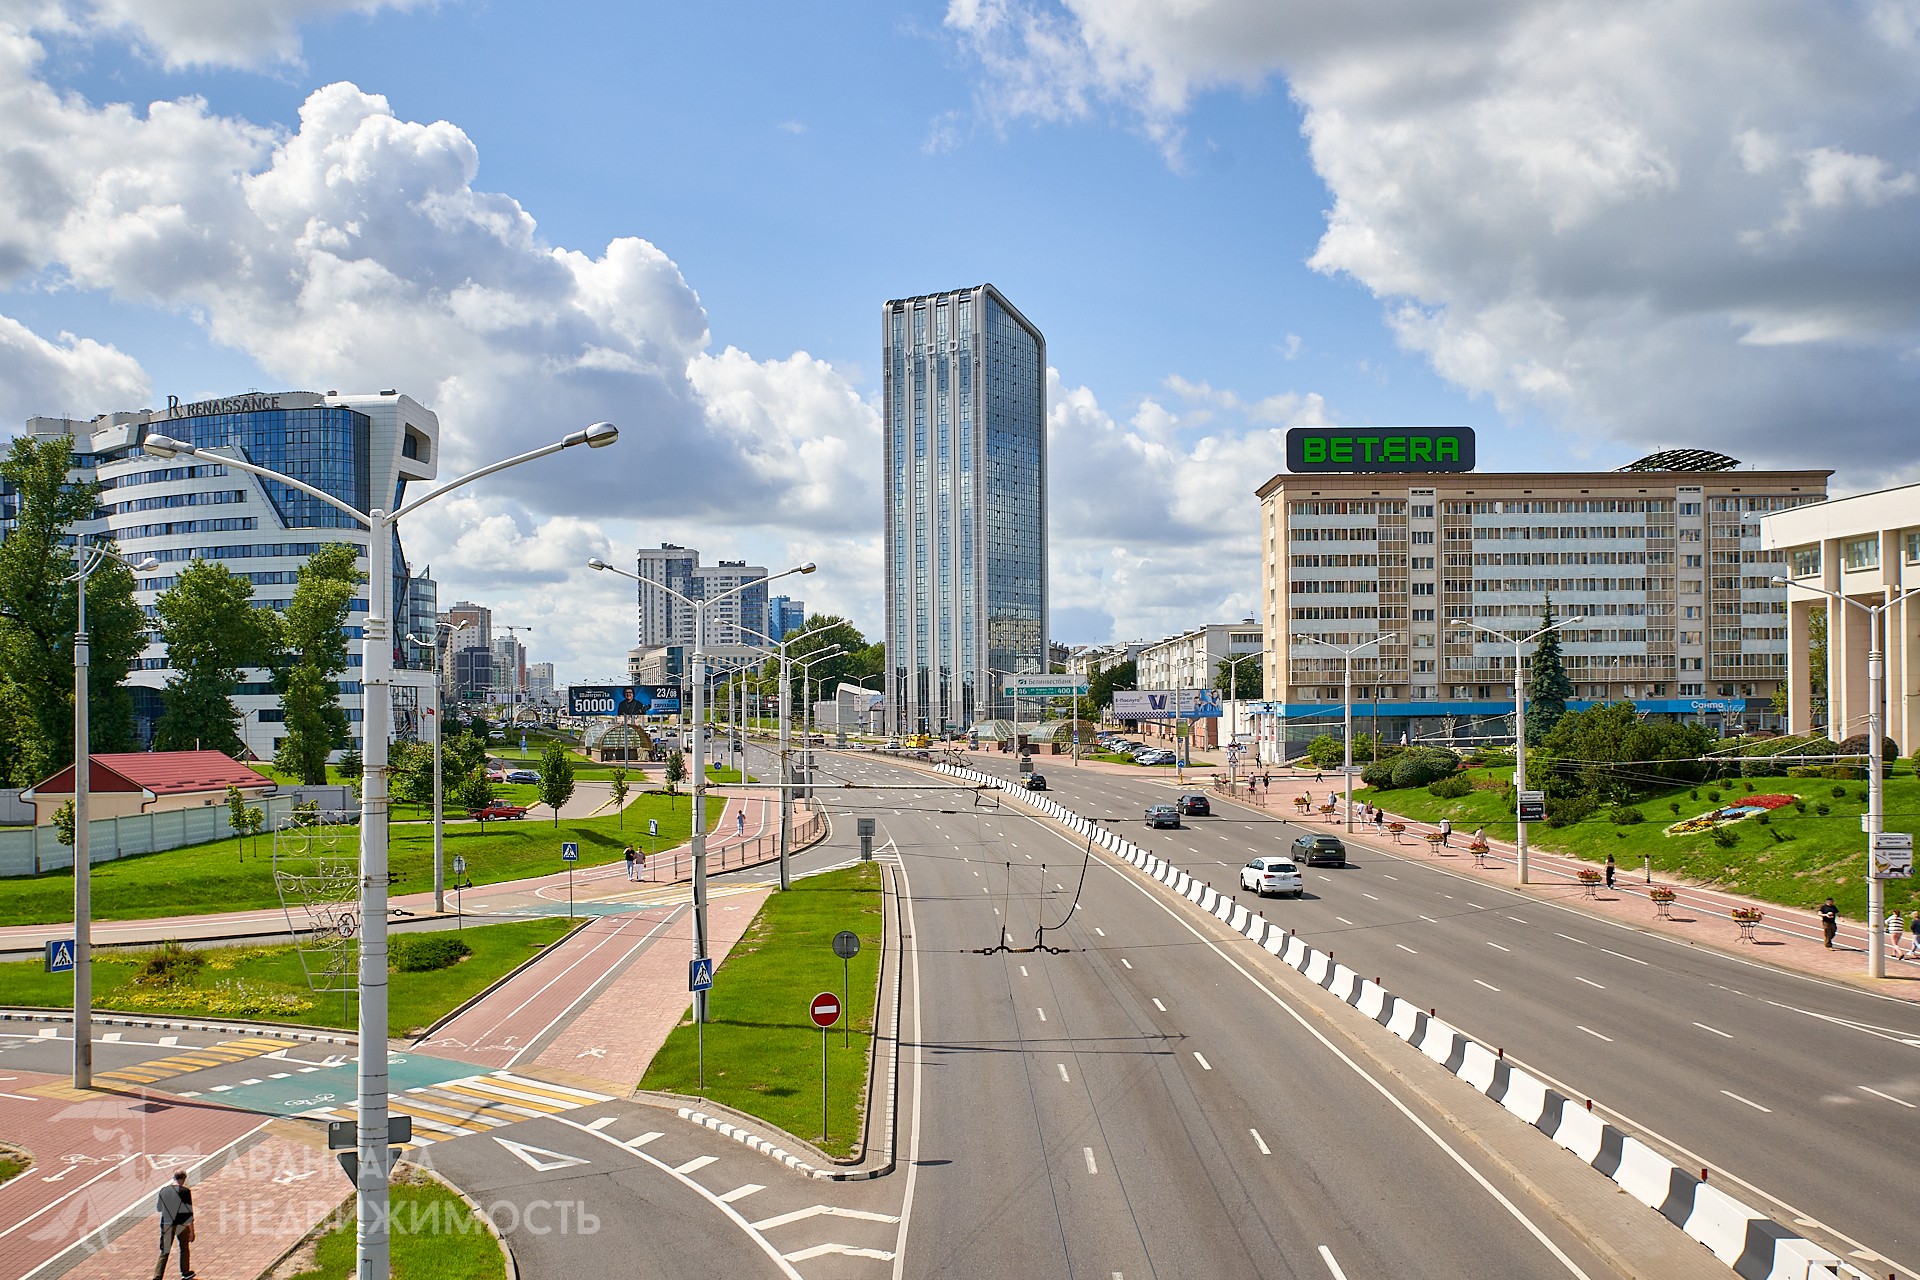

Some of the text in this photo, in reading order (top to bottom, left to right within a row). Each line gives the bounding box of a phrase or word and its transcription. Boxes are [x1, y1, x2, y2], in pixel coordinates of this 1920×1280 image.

[187, 397, 280, 416] RENAISSANCE
[574, 699, 615, 712] 50000
[1691, 700, 1724, 709] Санта
